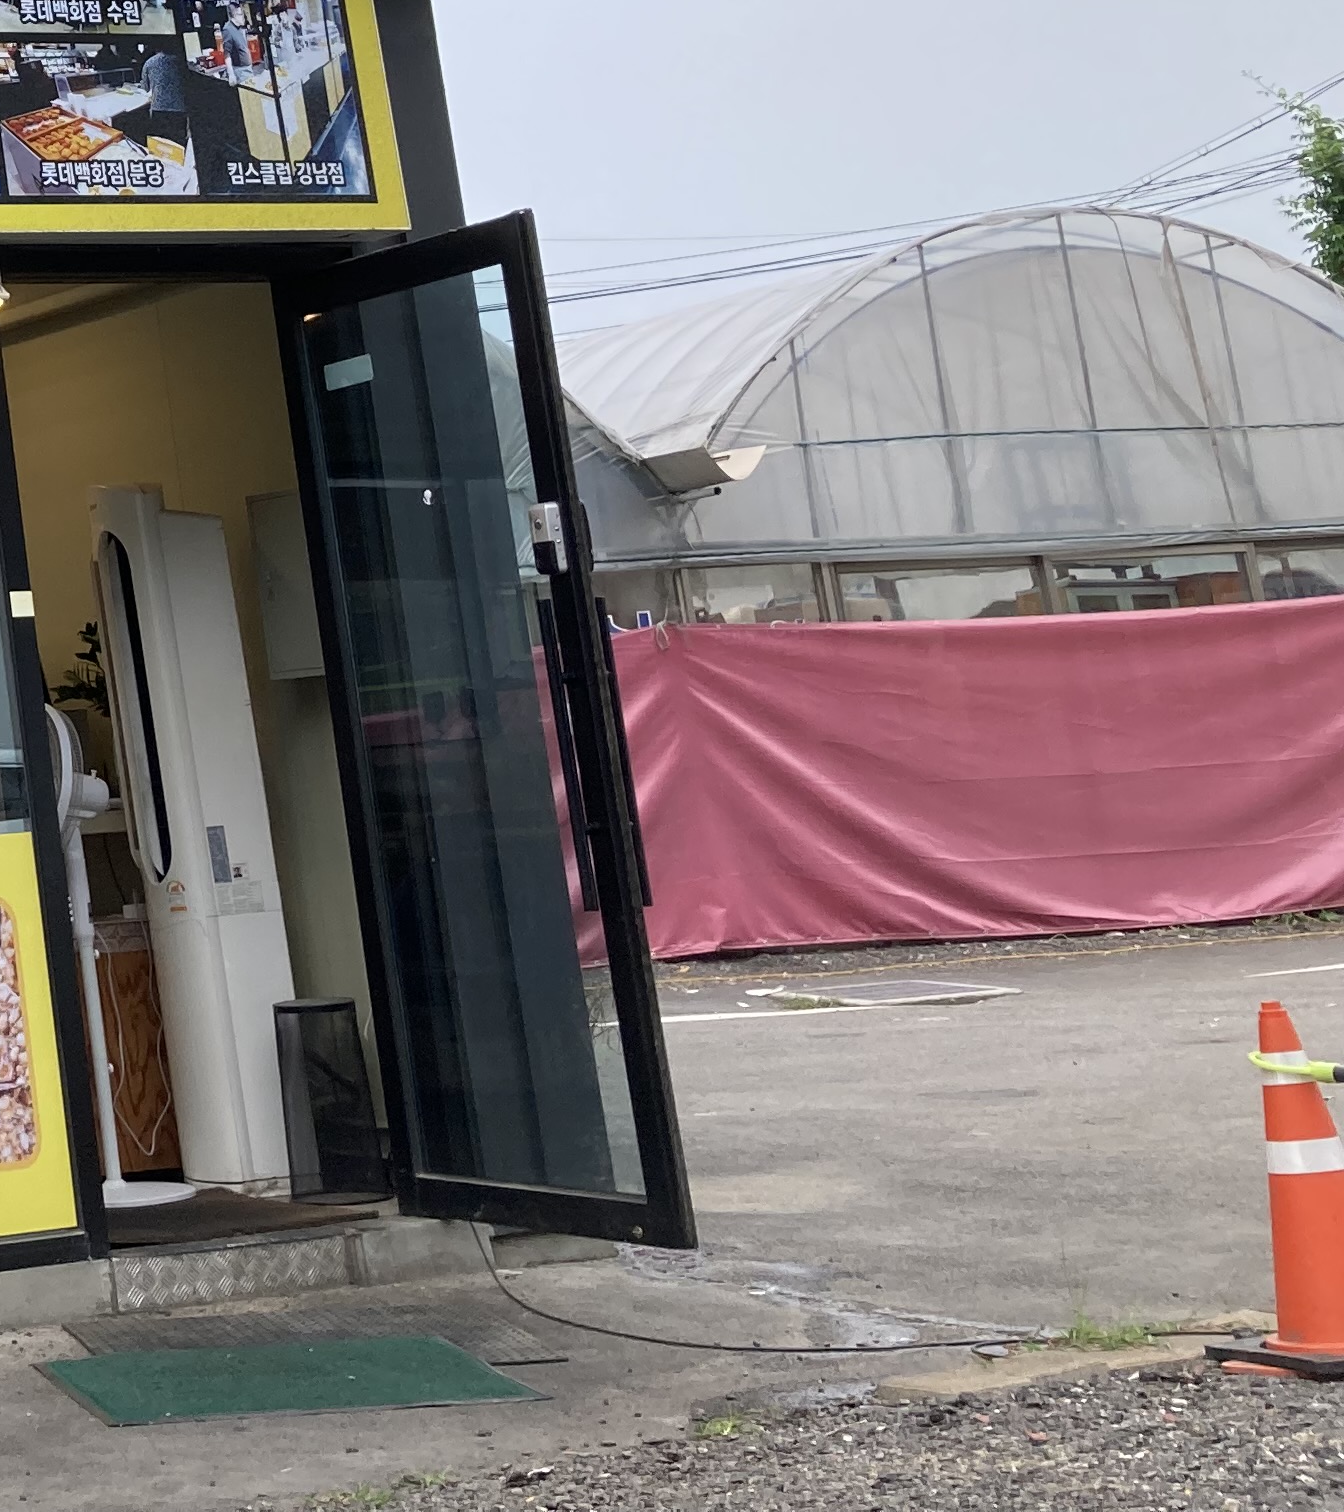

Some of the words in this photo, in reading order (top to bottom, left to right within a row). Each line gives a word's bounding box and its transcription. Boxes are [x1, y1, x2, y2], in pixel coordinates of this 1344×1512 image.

[19, 0, 102, 24] 롯데백화점
[107, 0, 141, 24] 수원
[41, 160, 126, 186] 롯데백화점
[129, 161, 163, 186] 분당
[295, 162, 345, 186] 강남점
